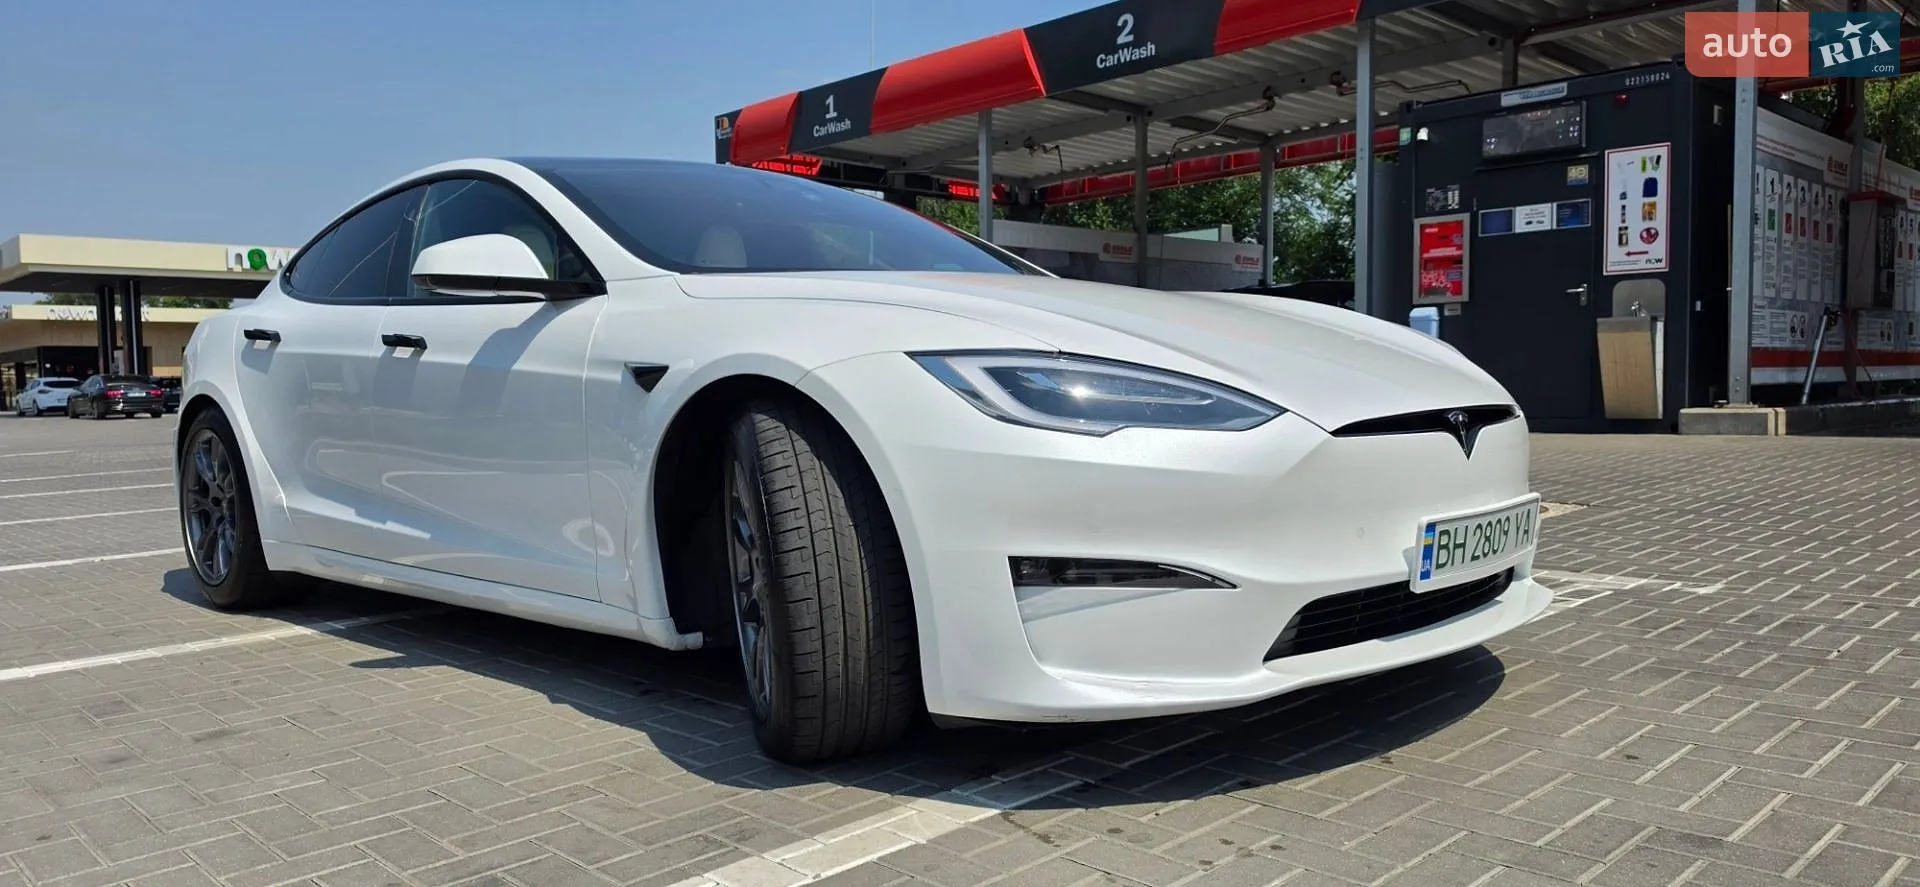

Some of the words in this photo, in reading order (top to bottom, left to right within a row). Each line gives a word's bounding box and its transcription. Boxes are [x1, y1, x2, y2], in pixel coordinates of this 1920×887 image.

[1117, 13, 1134, 44] 2
[1096, 41, 1155, 68] CarWash
[825, 94, 837, 119] 1
[813, 118, 851, 137] CarWash
[1435, 525, 1468, 569] BH
[1471, 516, 1510, 562] 2809
[1514, 508, 1531, 547] YA
